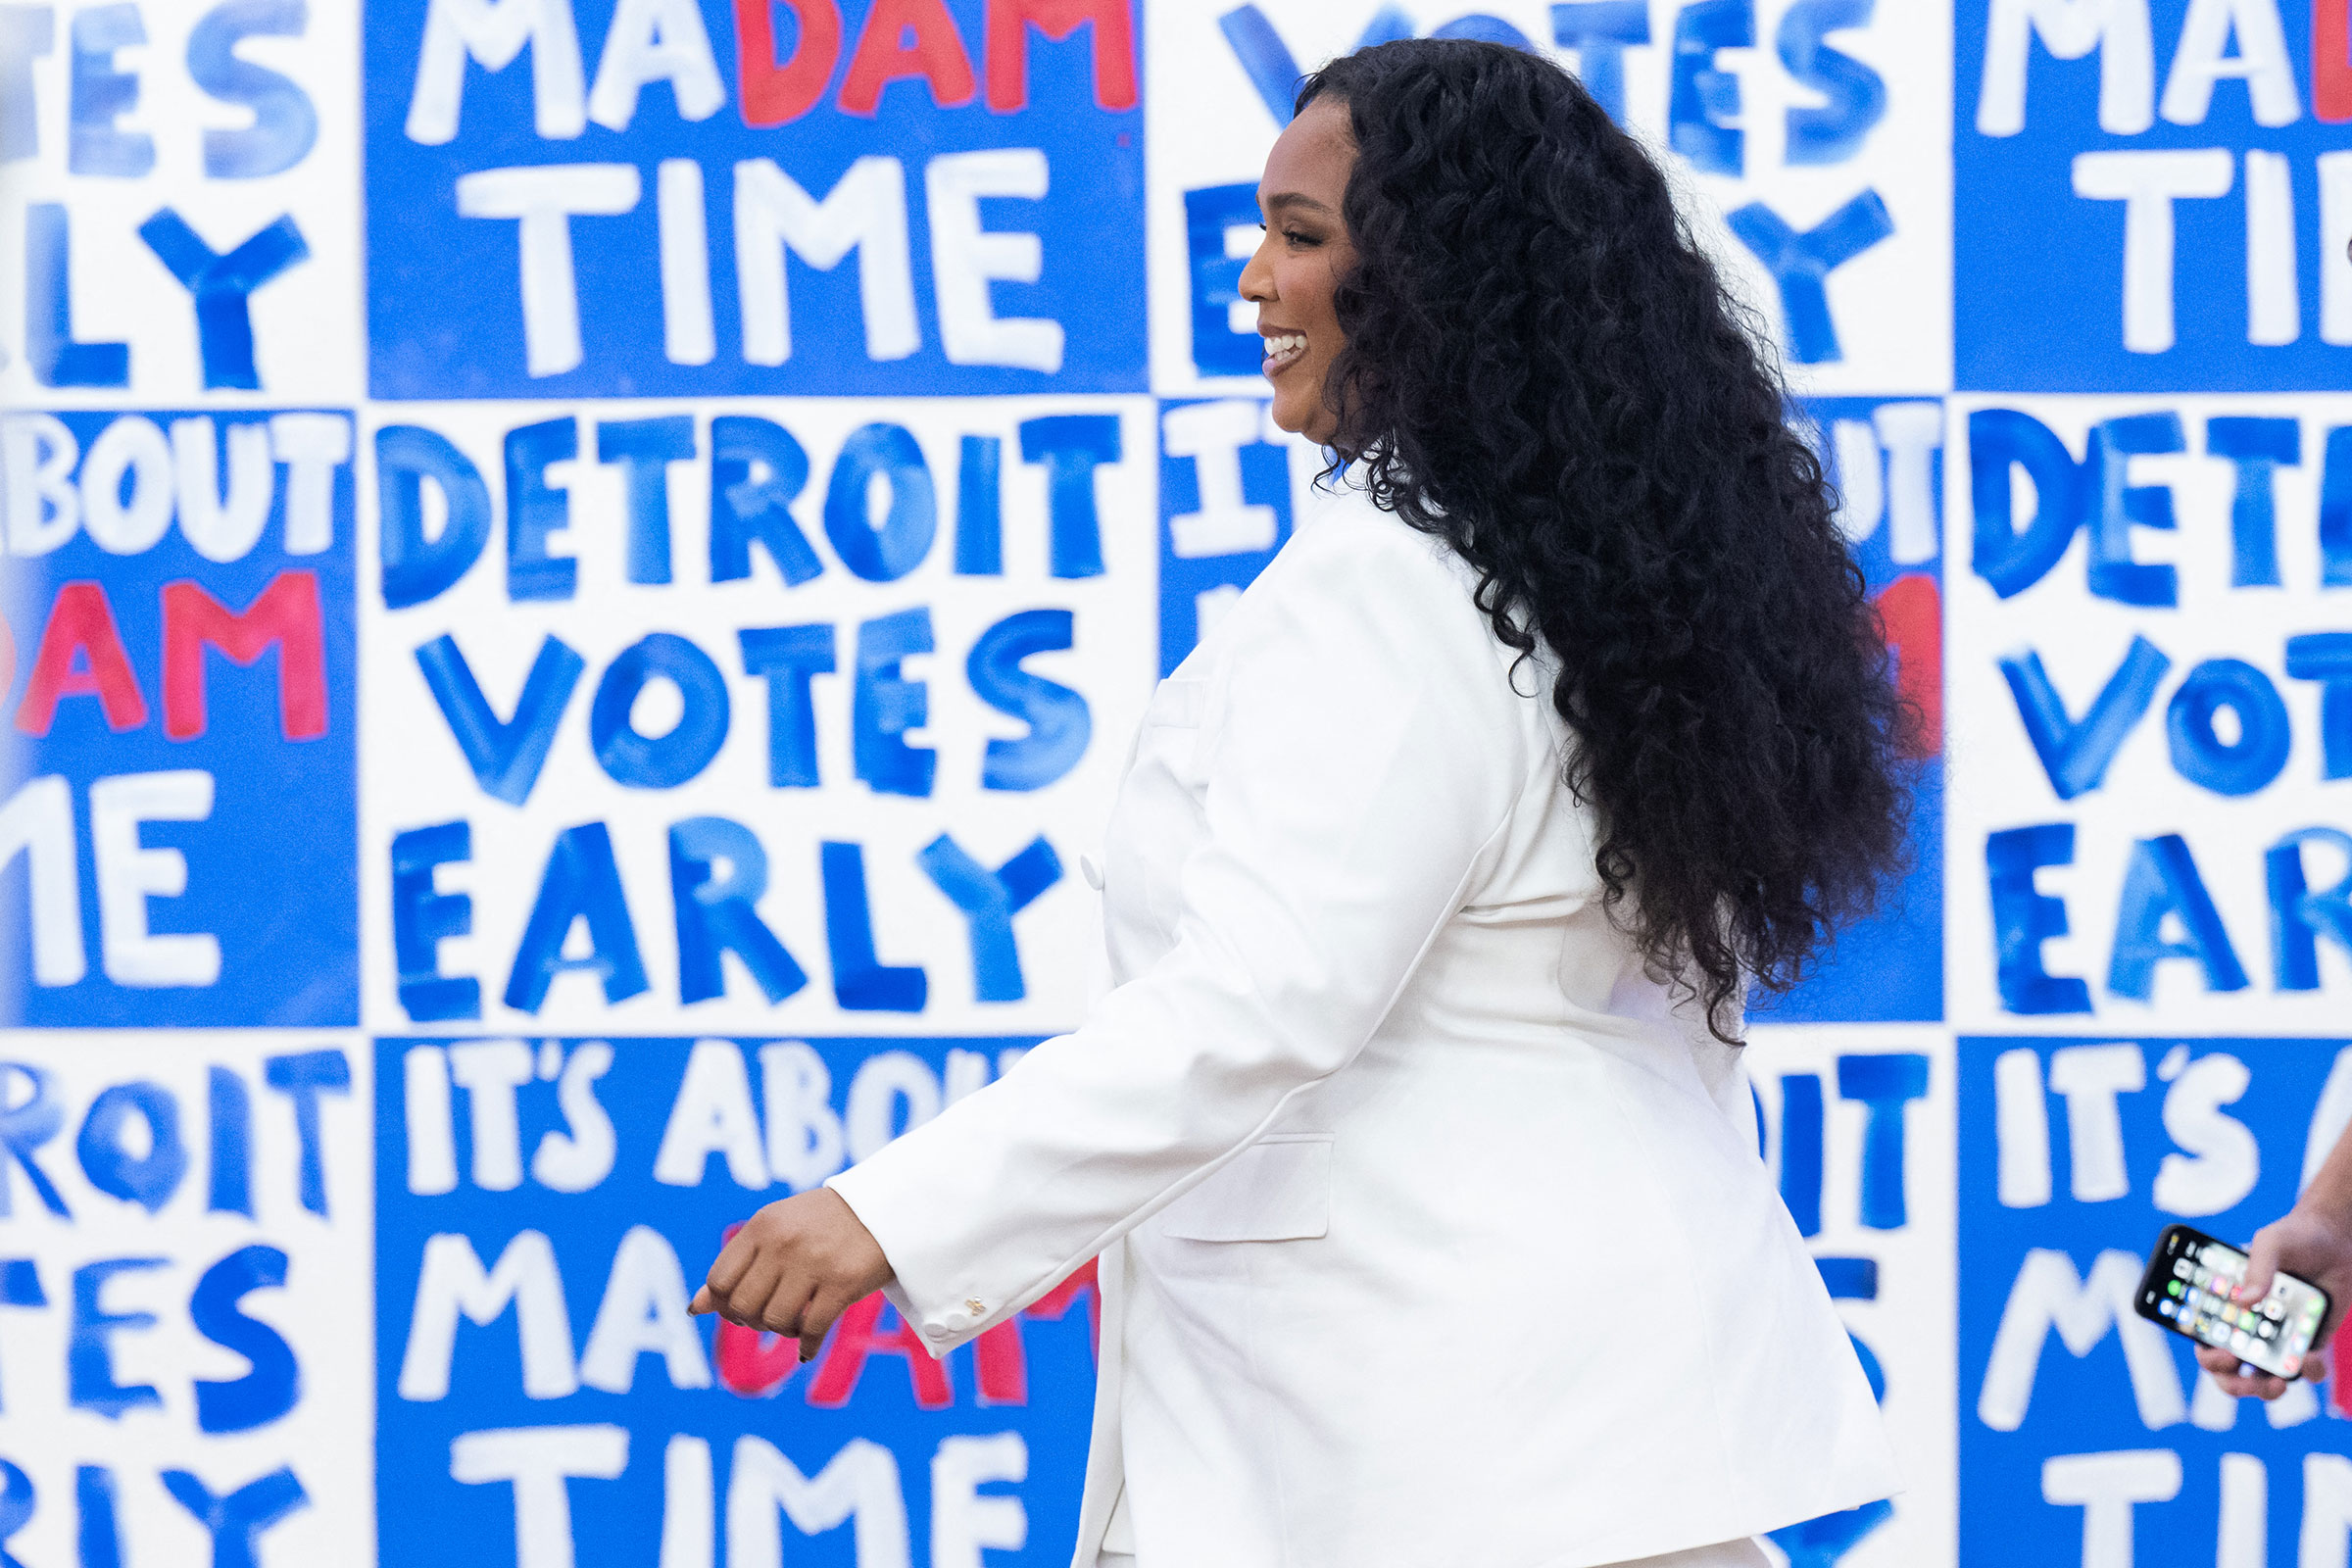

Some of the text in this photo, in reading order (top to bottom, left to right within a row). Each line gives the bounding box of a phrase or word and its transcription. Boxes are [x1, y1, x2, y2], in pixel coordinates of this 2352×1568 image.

[405, 0, 1142, 145] MADAM
[1218, 0, 1888, 179] VTES
[456, 148, 1064, 377] TIME
[2072, 147, 2352, 354] TI
[372, 413, 1124, 611] DETROIT
[1966, 407, 2352, 610] DET
[0, 569, 328, 743] AM
[413, 606, 1093, 808] VOTES
[391, 814, 1064, 1023] EARLY
[1985, 820, 2352, 1017] EAR
[404, 1038, 616, 1197] IT'S
[1994, 1042, 2261, 1217] IT'S
[450, 1423, 1028, 1568] TIME
[2041, 1448, 2352, 1568] TI
